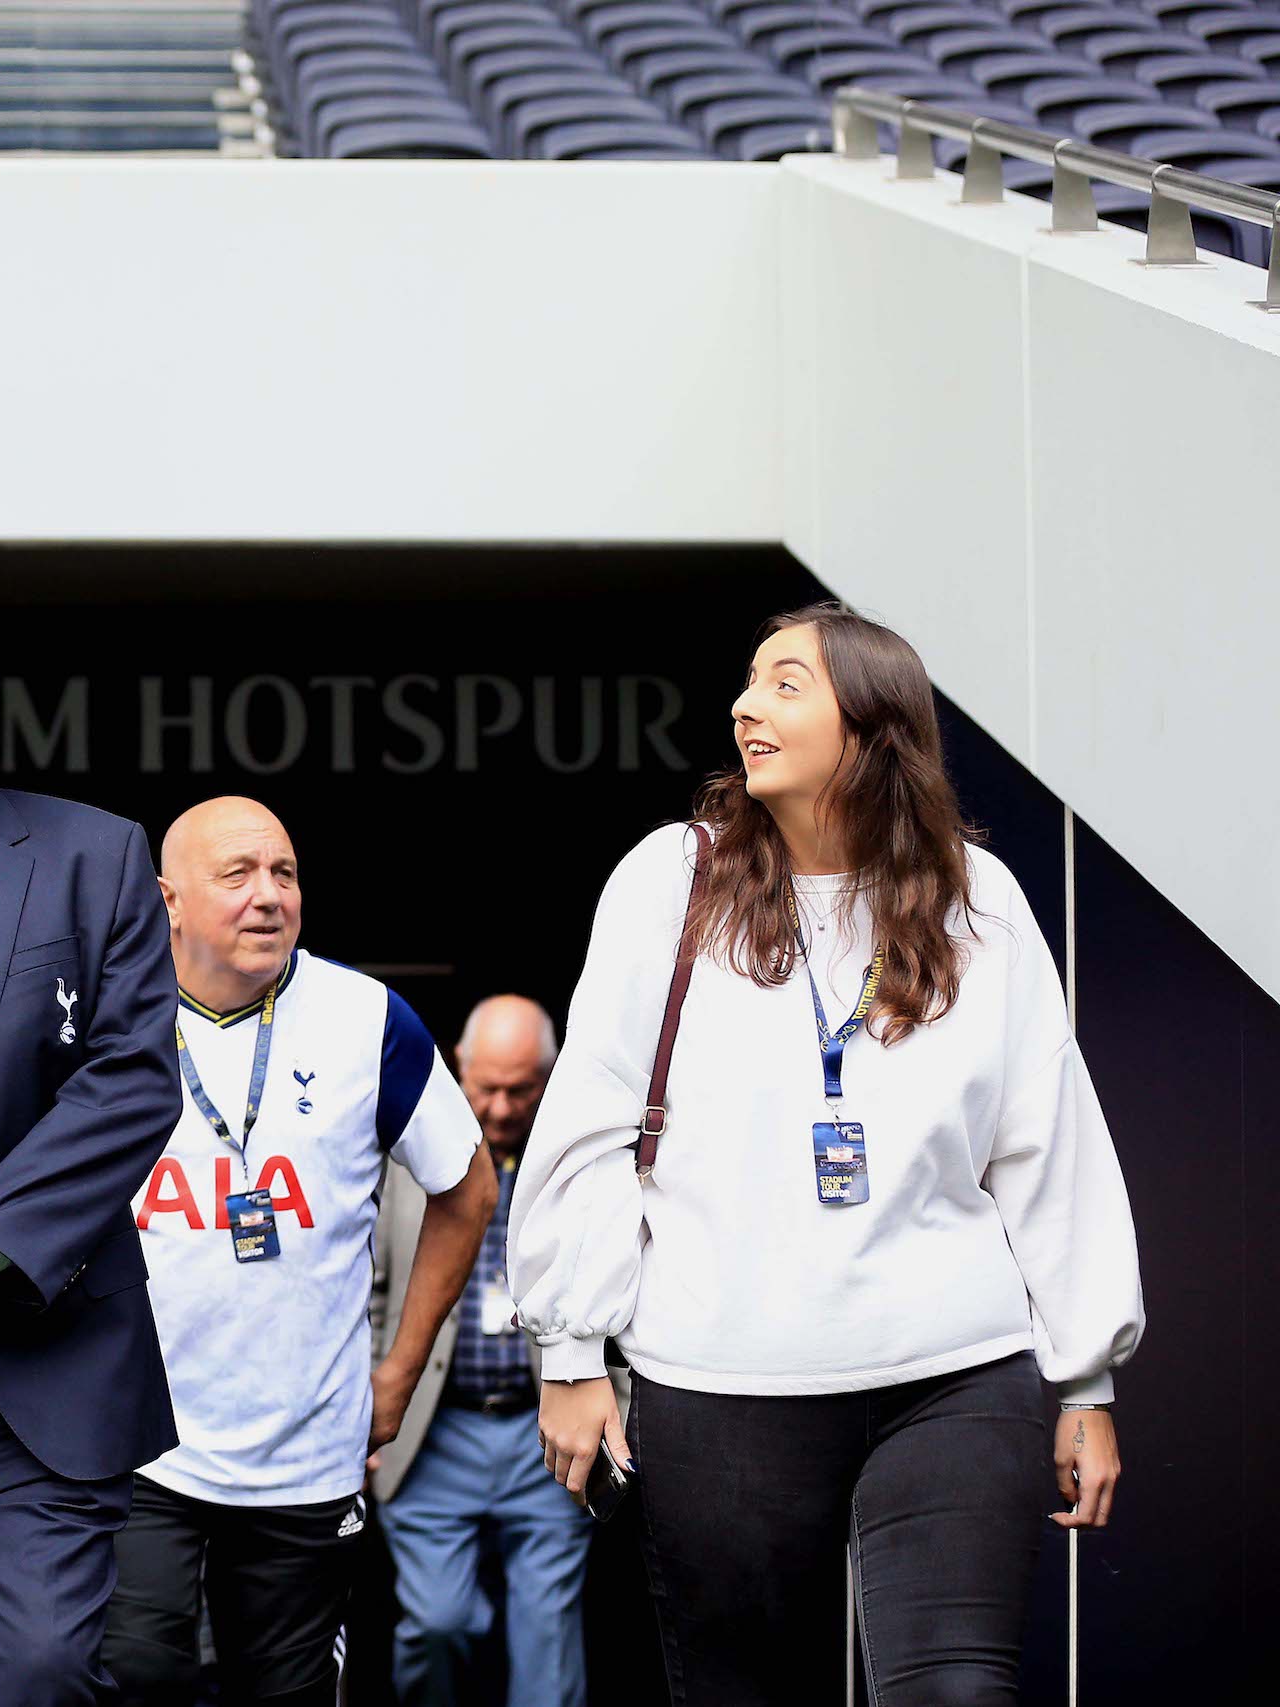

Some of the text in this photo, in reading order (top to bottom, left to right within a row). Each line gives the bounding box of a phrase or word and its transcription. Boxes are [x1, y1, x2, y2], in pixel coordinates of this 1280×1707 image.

[139, 673, 692, 775] HOTSPUR
[851, 955, 885, 1021] TOTTENHAM
[261, 984, 276, 1025] TSPUR
[136, 1155, 315, 1230] AIA
[819, 1175, 853, 1184] STADIUM
[821, 1183, 841, 1191] TOUR
[821, 1190, 851, 1198] VISITOR
[237, 1247, 265, 1259] VISITOR
